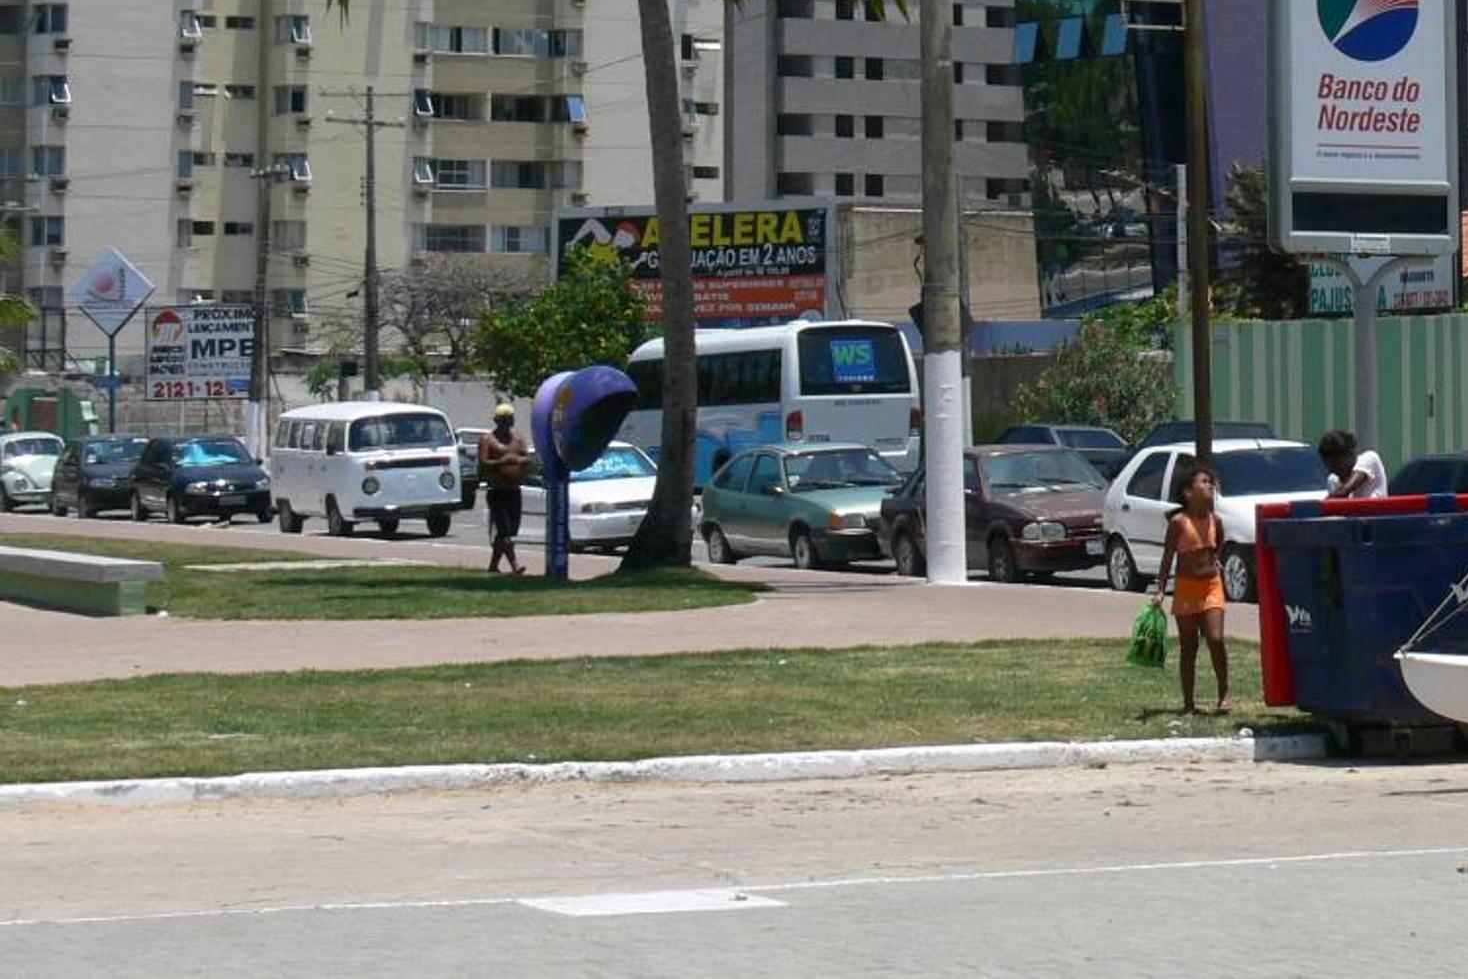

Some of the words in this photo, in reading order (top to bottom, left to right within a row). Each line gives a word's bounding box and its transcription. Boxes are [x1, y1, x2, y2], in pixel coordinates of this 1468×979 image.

[1317, 73, 1388, 101] Banco
[1392, 76, 1420, 102] do
[1317, 104, 1421, 133] Nordeste
[640, 210, 804, 248] AELERA
[739, 250, 758, 266] EM
[763, 243, 773, 266] 2
[777, 245, 816, 265] ANOS
